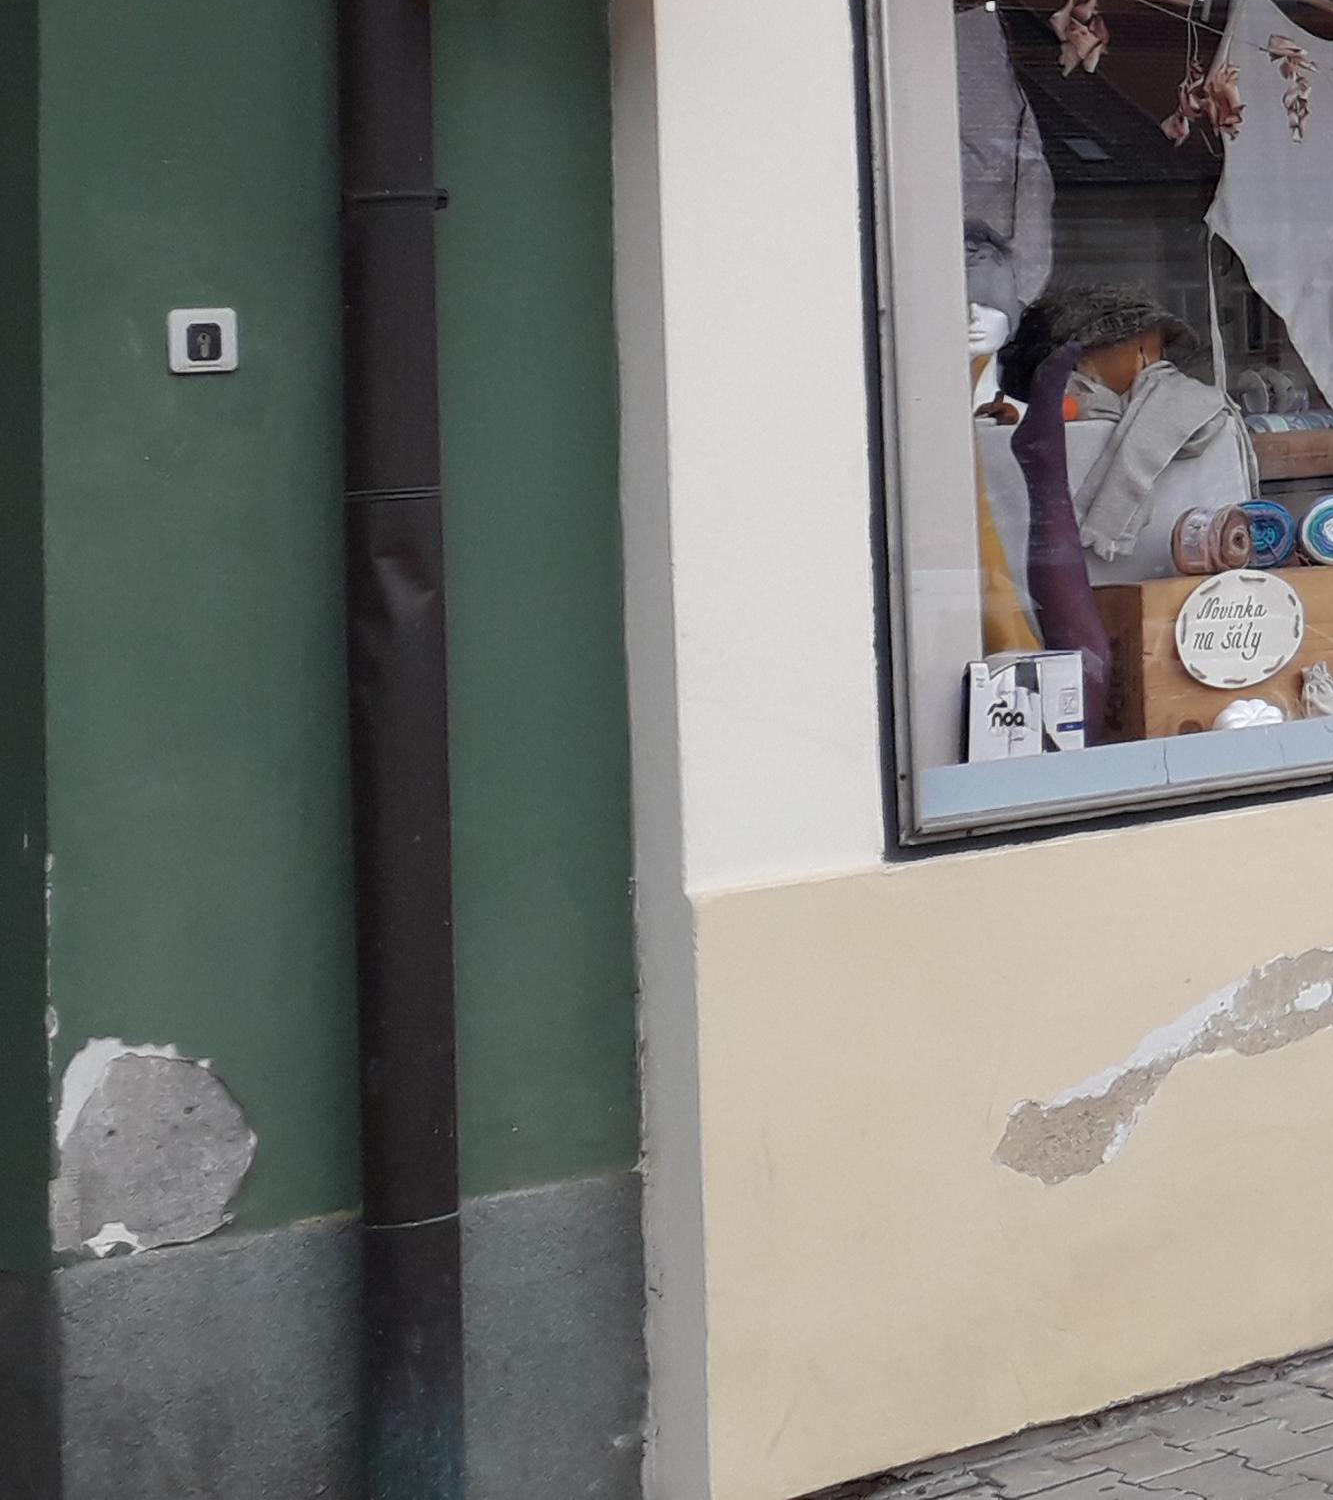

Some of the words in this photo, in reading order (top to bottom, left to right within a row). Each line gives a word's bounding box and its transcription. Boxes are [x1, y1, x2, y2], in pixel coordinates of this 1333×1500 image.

[1196, 595, 1268, 620] Novinka
[1192, 631, 1215, 651] na
[1220, 621, 1262, 661] šály
[991, 712, 1025, 728] noa
